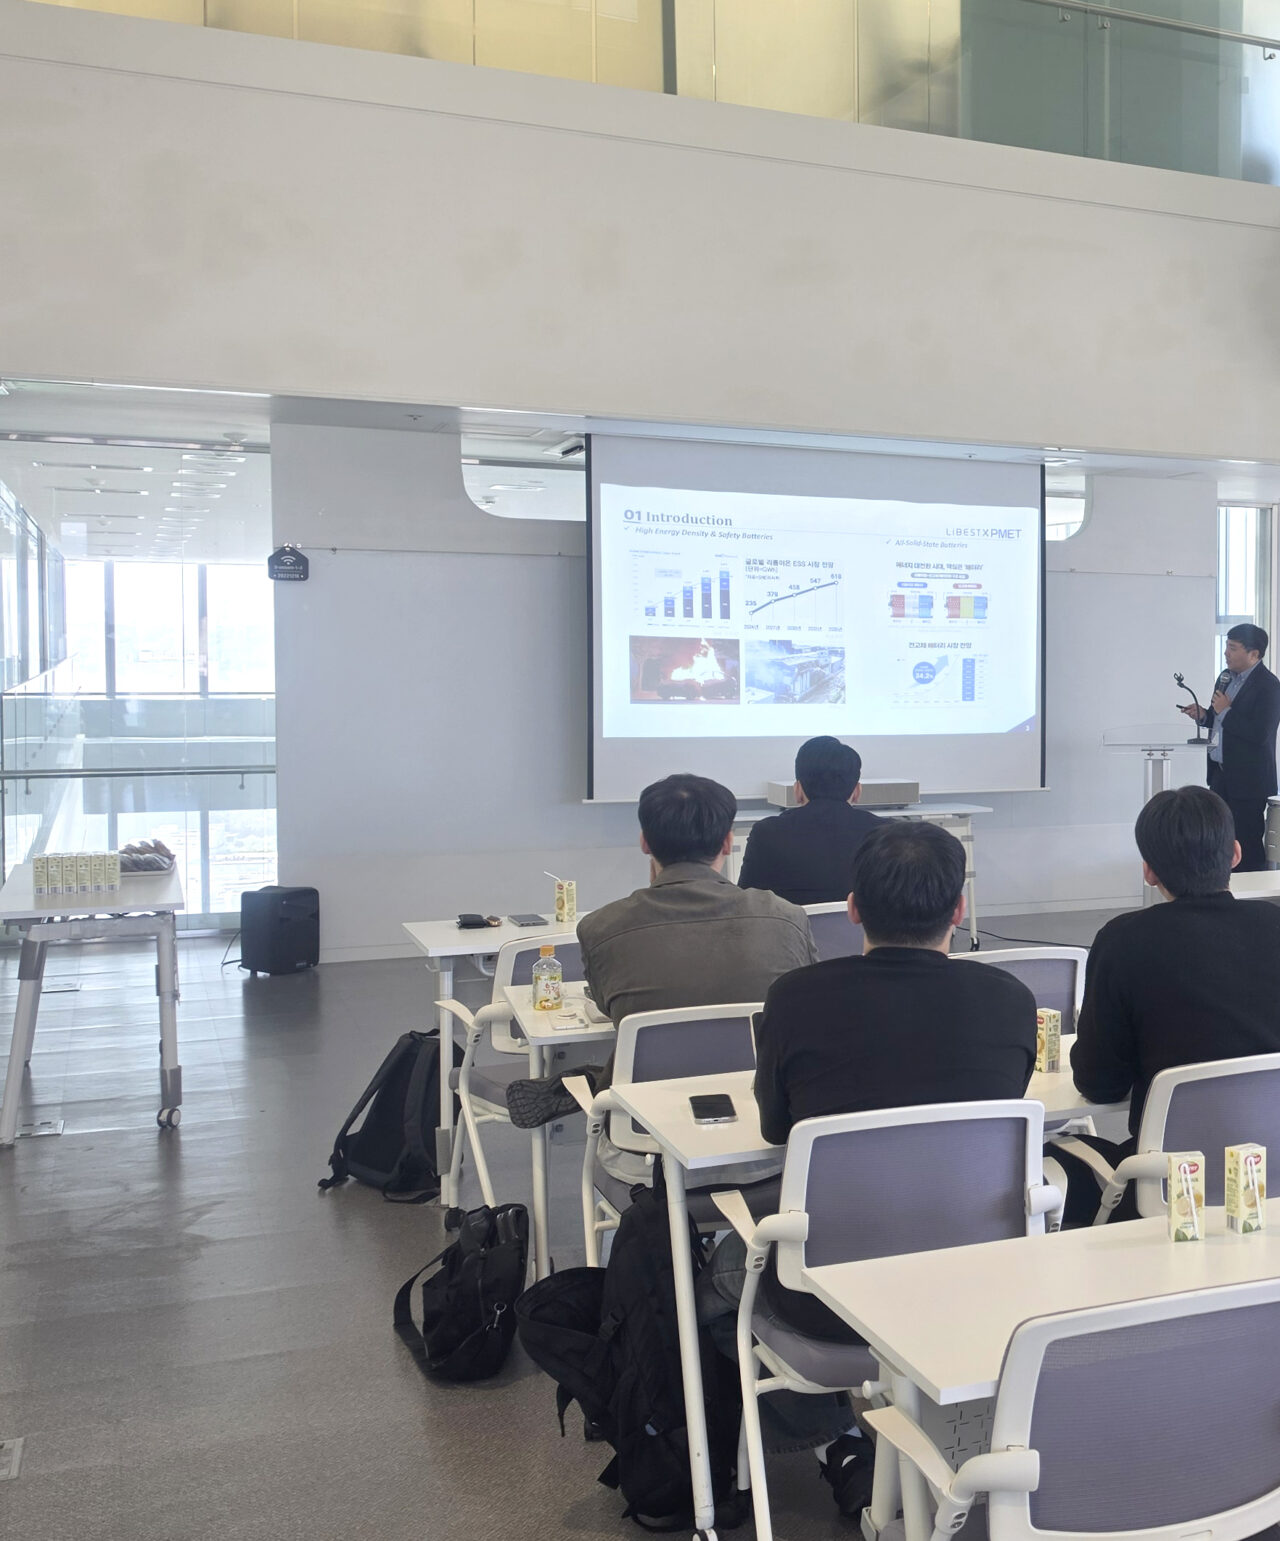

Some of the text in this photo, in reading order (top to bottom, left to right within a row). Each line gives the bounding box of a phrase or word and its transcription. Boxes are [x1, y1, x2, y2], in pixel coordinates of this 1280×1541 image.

[646, 511, 733, 527] Introduction
[635, 526, 773, 541] High Energy Density & Safety Batteries
[895, 539, 939, 548] All-Solid-State
[745, 558, 764, 566] 글로벌
[793, 560, 806, 568] ESS
[807, 561, 820, 569] 시장
